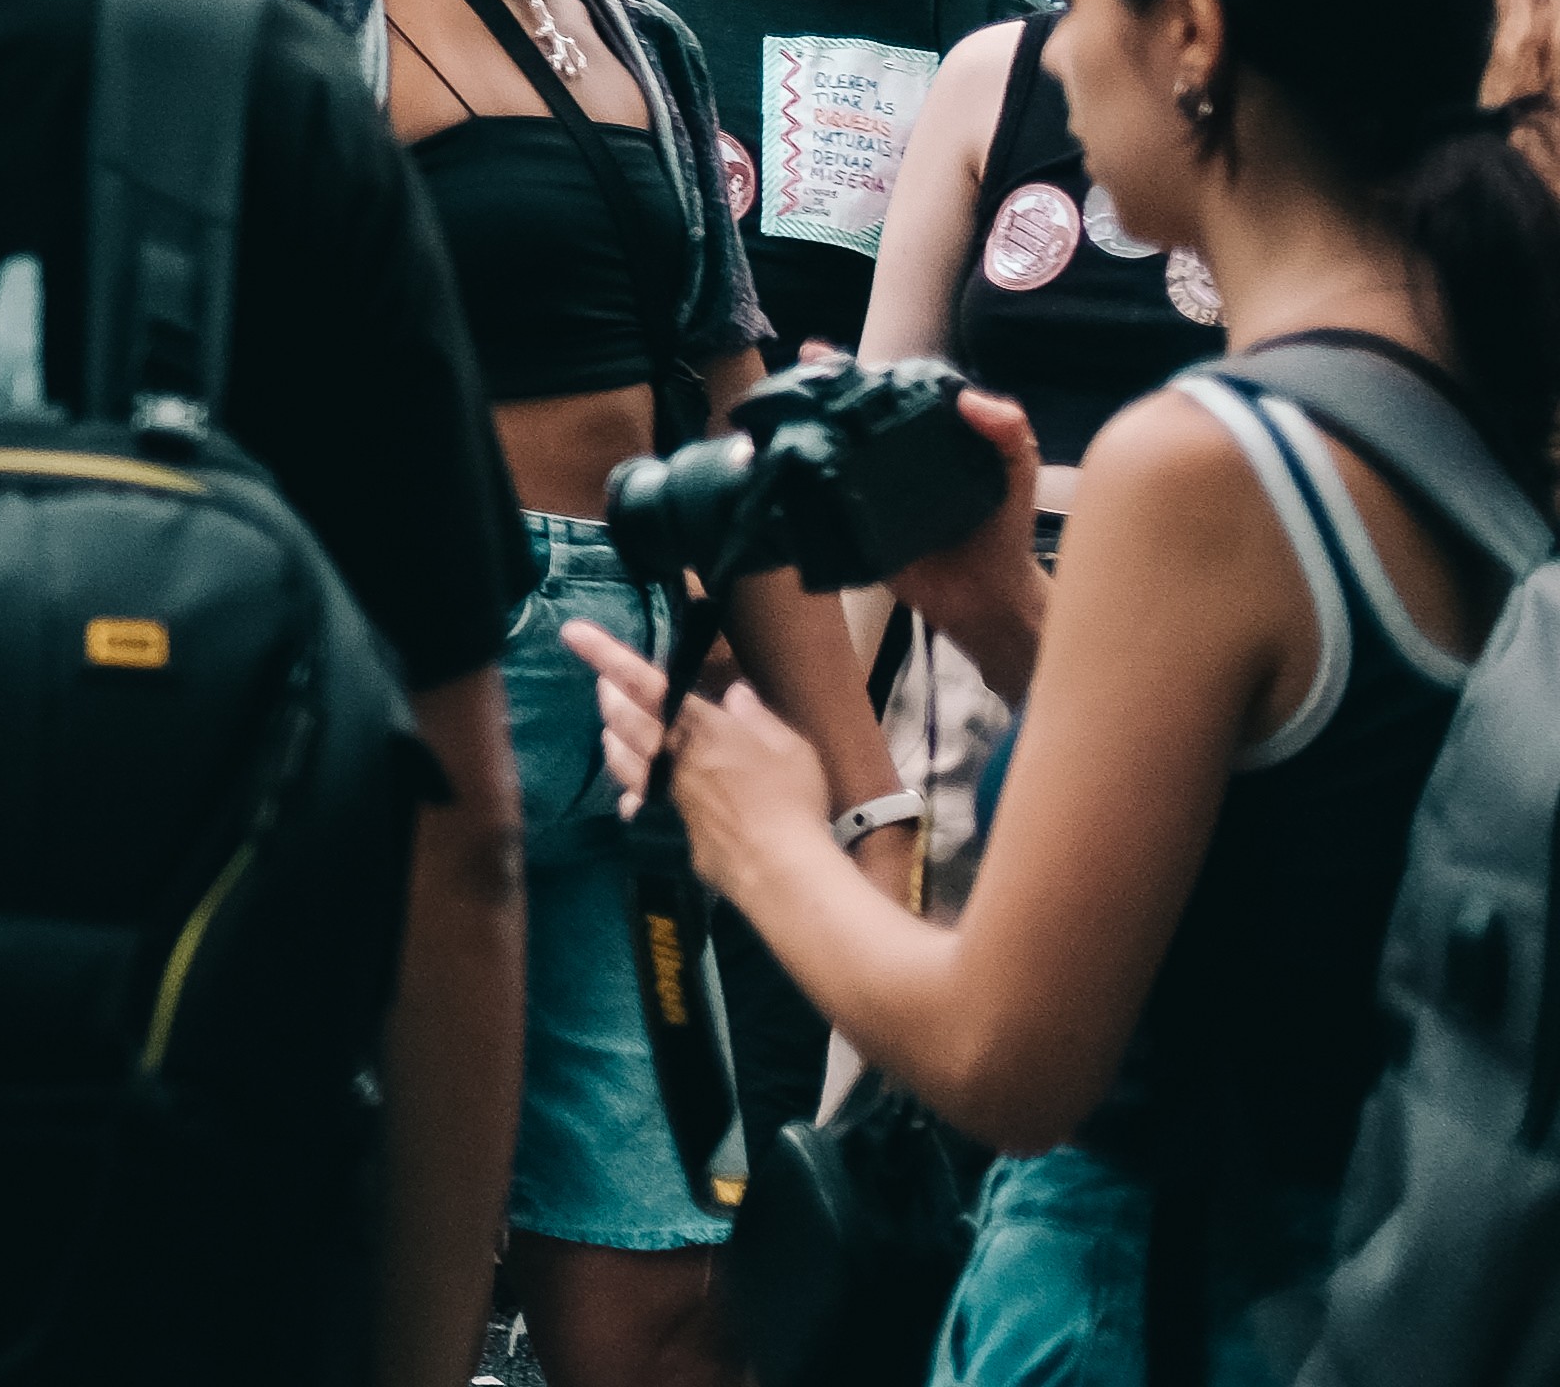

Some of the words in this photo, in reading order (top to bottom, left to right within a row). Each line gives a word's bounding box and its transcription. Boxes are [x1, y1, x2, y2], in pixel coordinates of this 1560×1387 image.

[811, 91, 864, 111] TIRAR
[874, 100, 895, 116] AS
[812, 130, 893, 158] NATURAIS
[812, 149, 873, 170] DEIXAR
